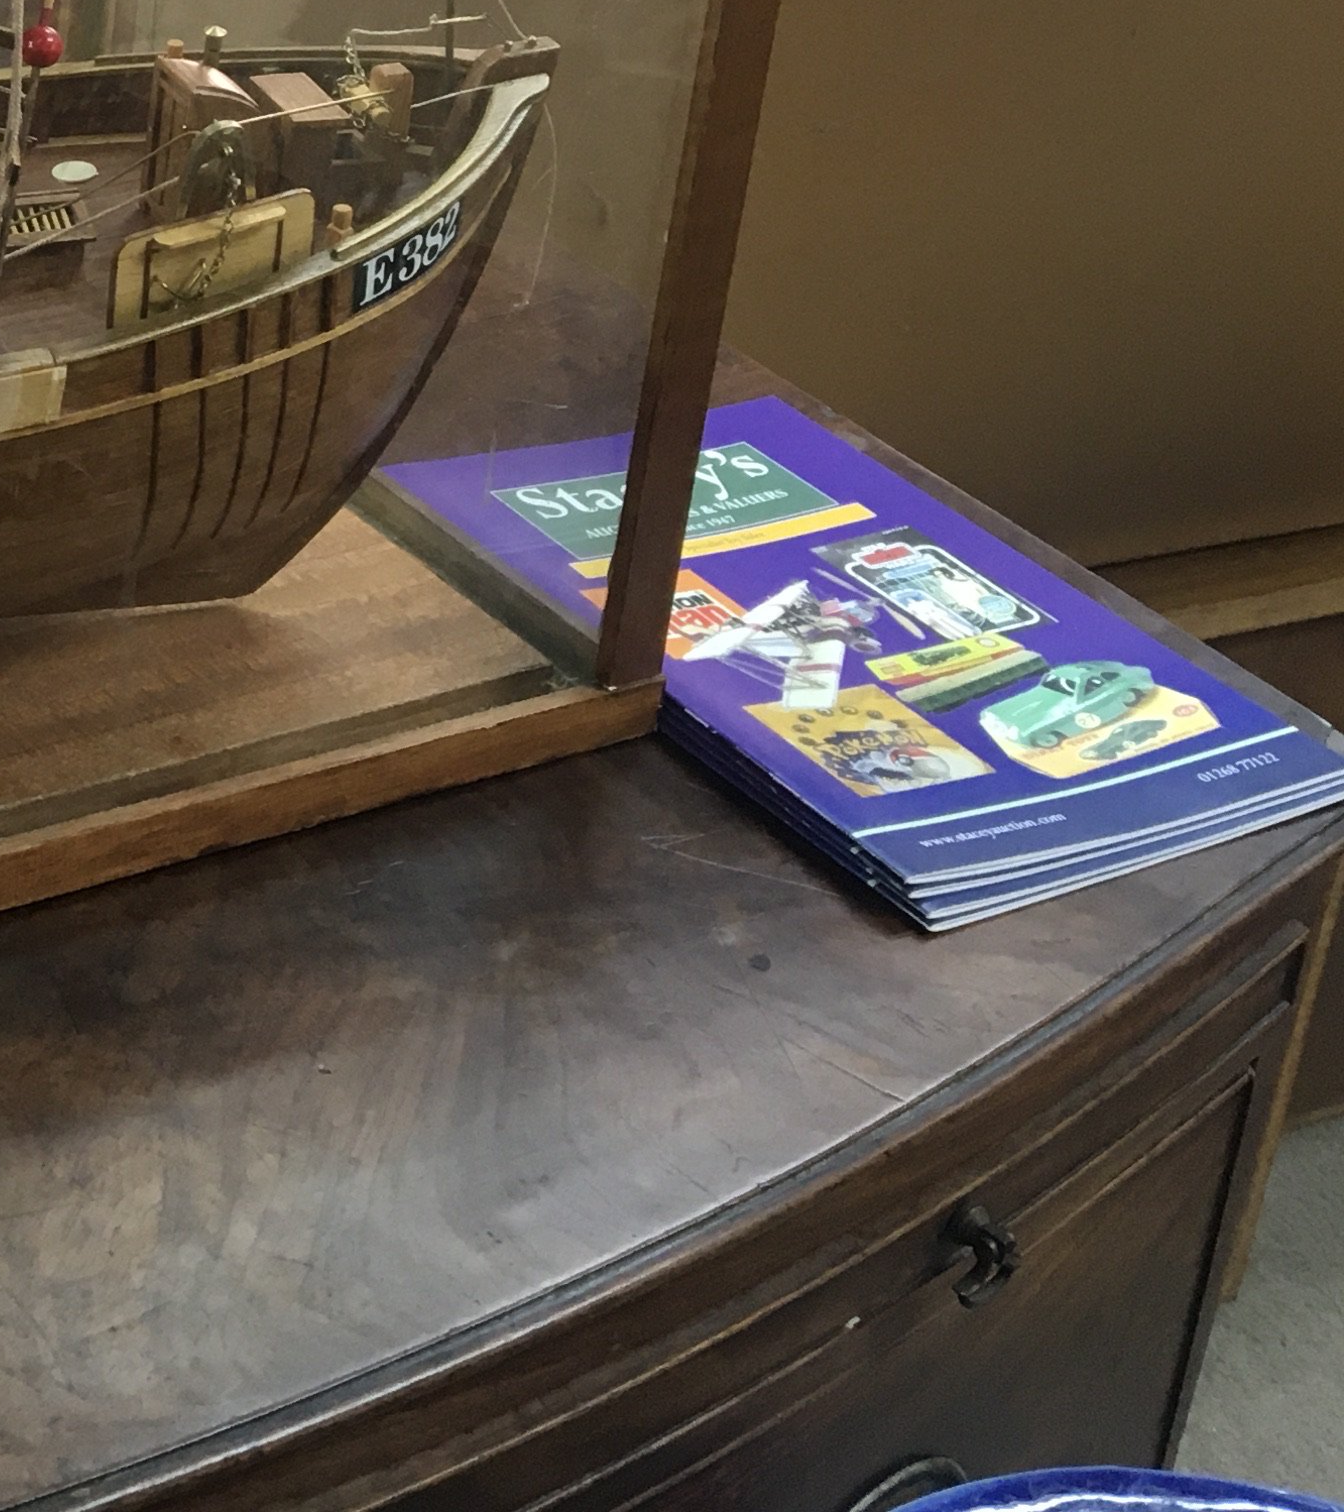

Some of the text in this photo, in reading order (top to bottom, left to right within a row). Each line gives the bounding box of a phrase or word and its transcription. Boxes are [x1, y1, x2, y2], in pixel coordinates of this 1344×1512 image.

[715, 488, 790, 511] VALUERS
[1196, 752, 1280, 783] 01268 77122
[918, 813, 1067, 848] www.staceyauction.com
